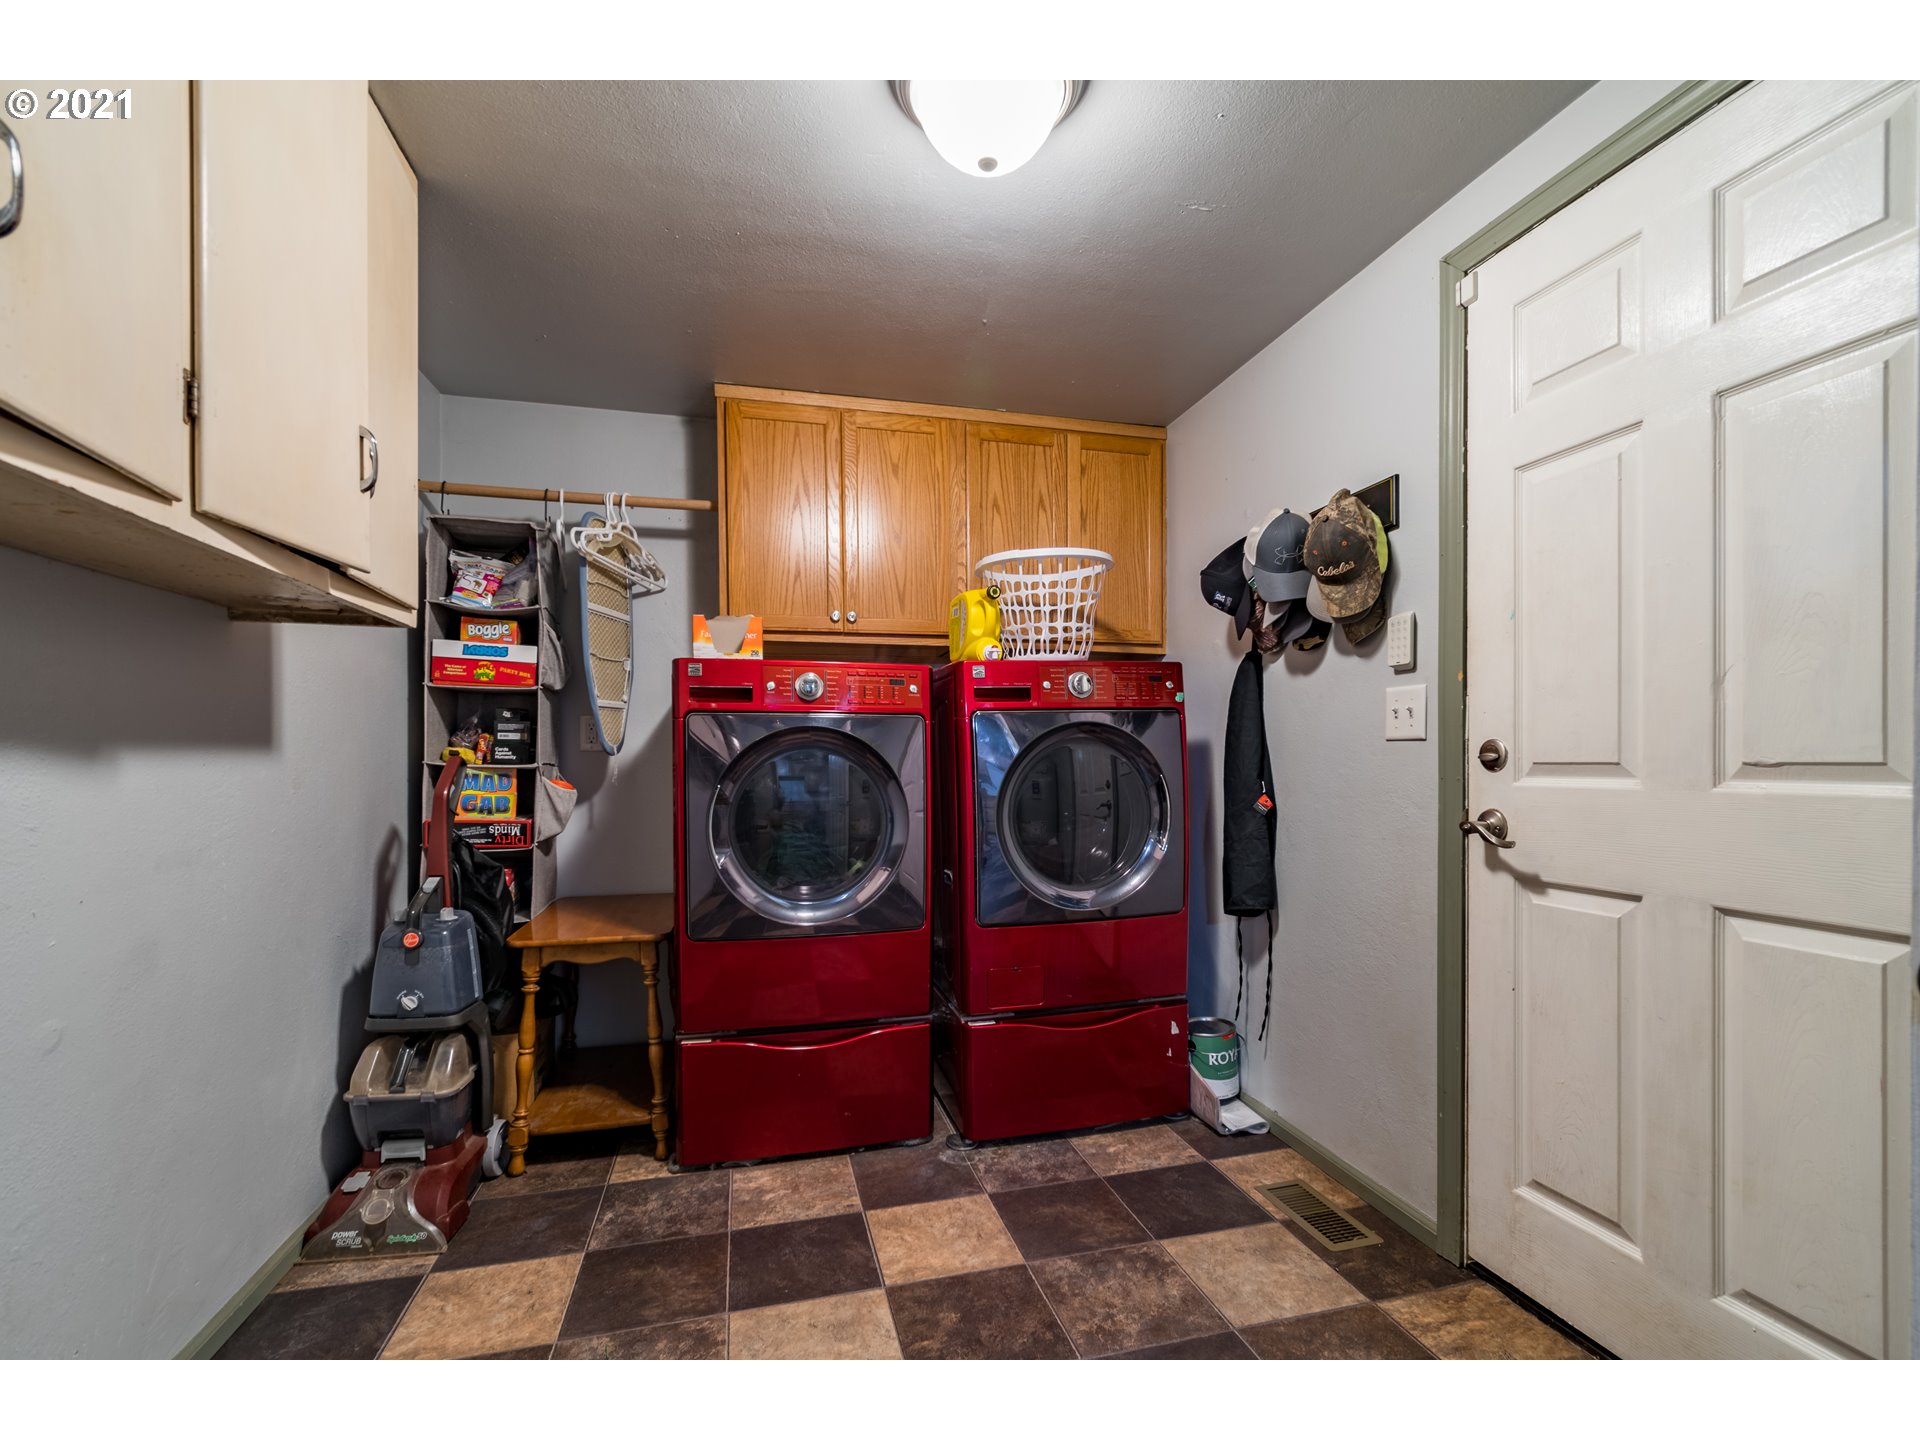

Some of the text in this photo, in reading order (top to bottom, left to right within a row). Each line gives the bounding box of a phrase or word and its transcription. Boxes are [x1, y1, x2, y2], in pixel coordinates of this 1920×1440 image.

[467, 621, 510, 639] Boggle
[499, 667, 518, 676] PARTY
[462, 773, 513, 792] MAD
[461, 794, 511, 816] GAB
[488, 825, 521, 836] Minds
[495, 834, 525, 846] Dirty
[331, 1230, 359, 1240] power
[336, 1237, 362, 1246] SCRUB
